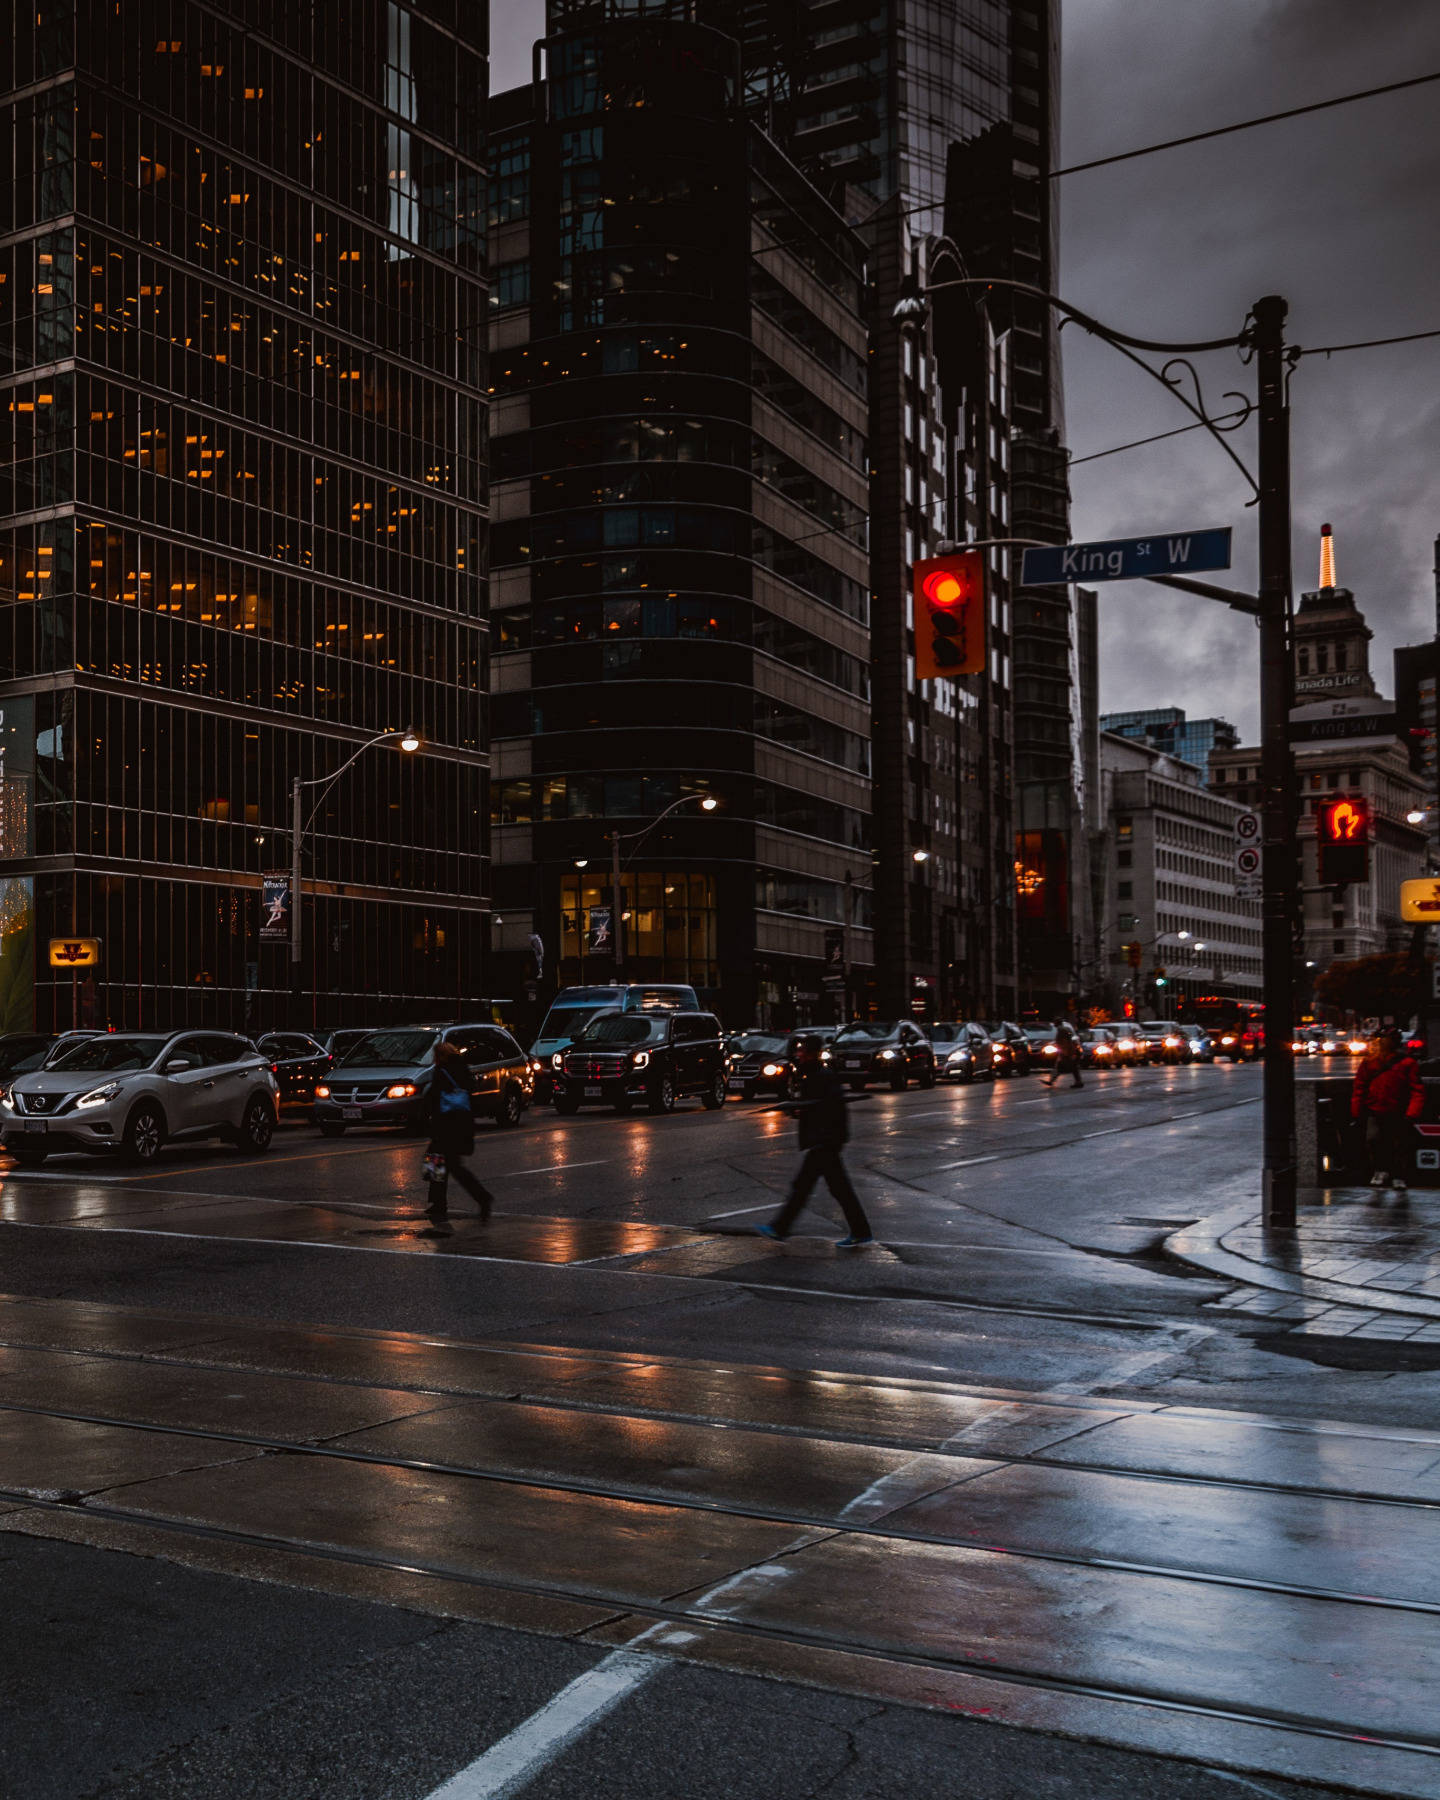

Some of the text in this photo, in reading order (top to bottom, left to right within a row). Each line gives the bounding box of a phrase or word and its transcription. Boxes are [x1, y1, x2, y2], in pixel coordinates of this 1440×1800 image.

[1062, 537, 1191, 576] King St W
[1295, 674, 1360, 690] anada Life
[1311, 721, 1346, 736] King
